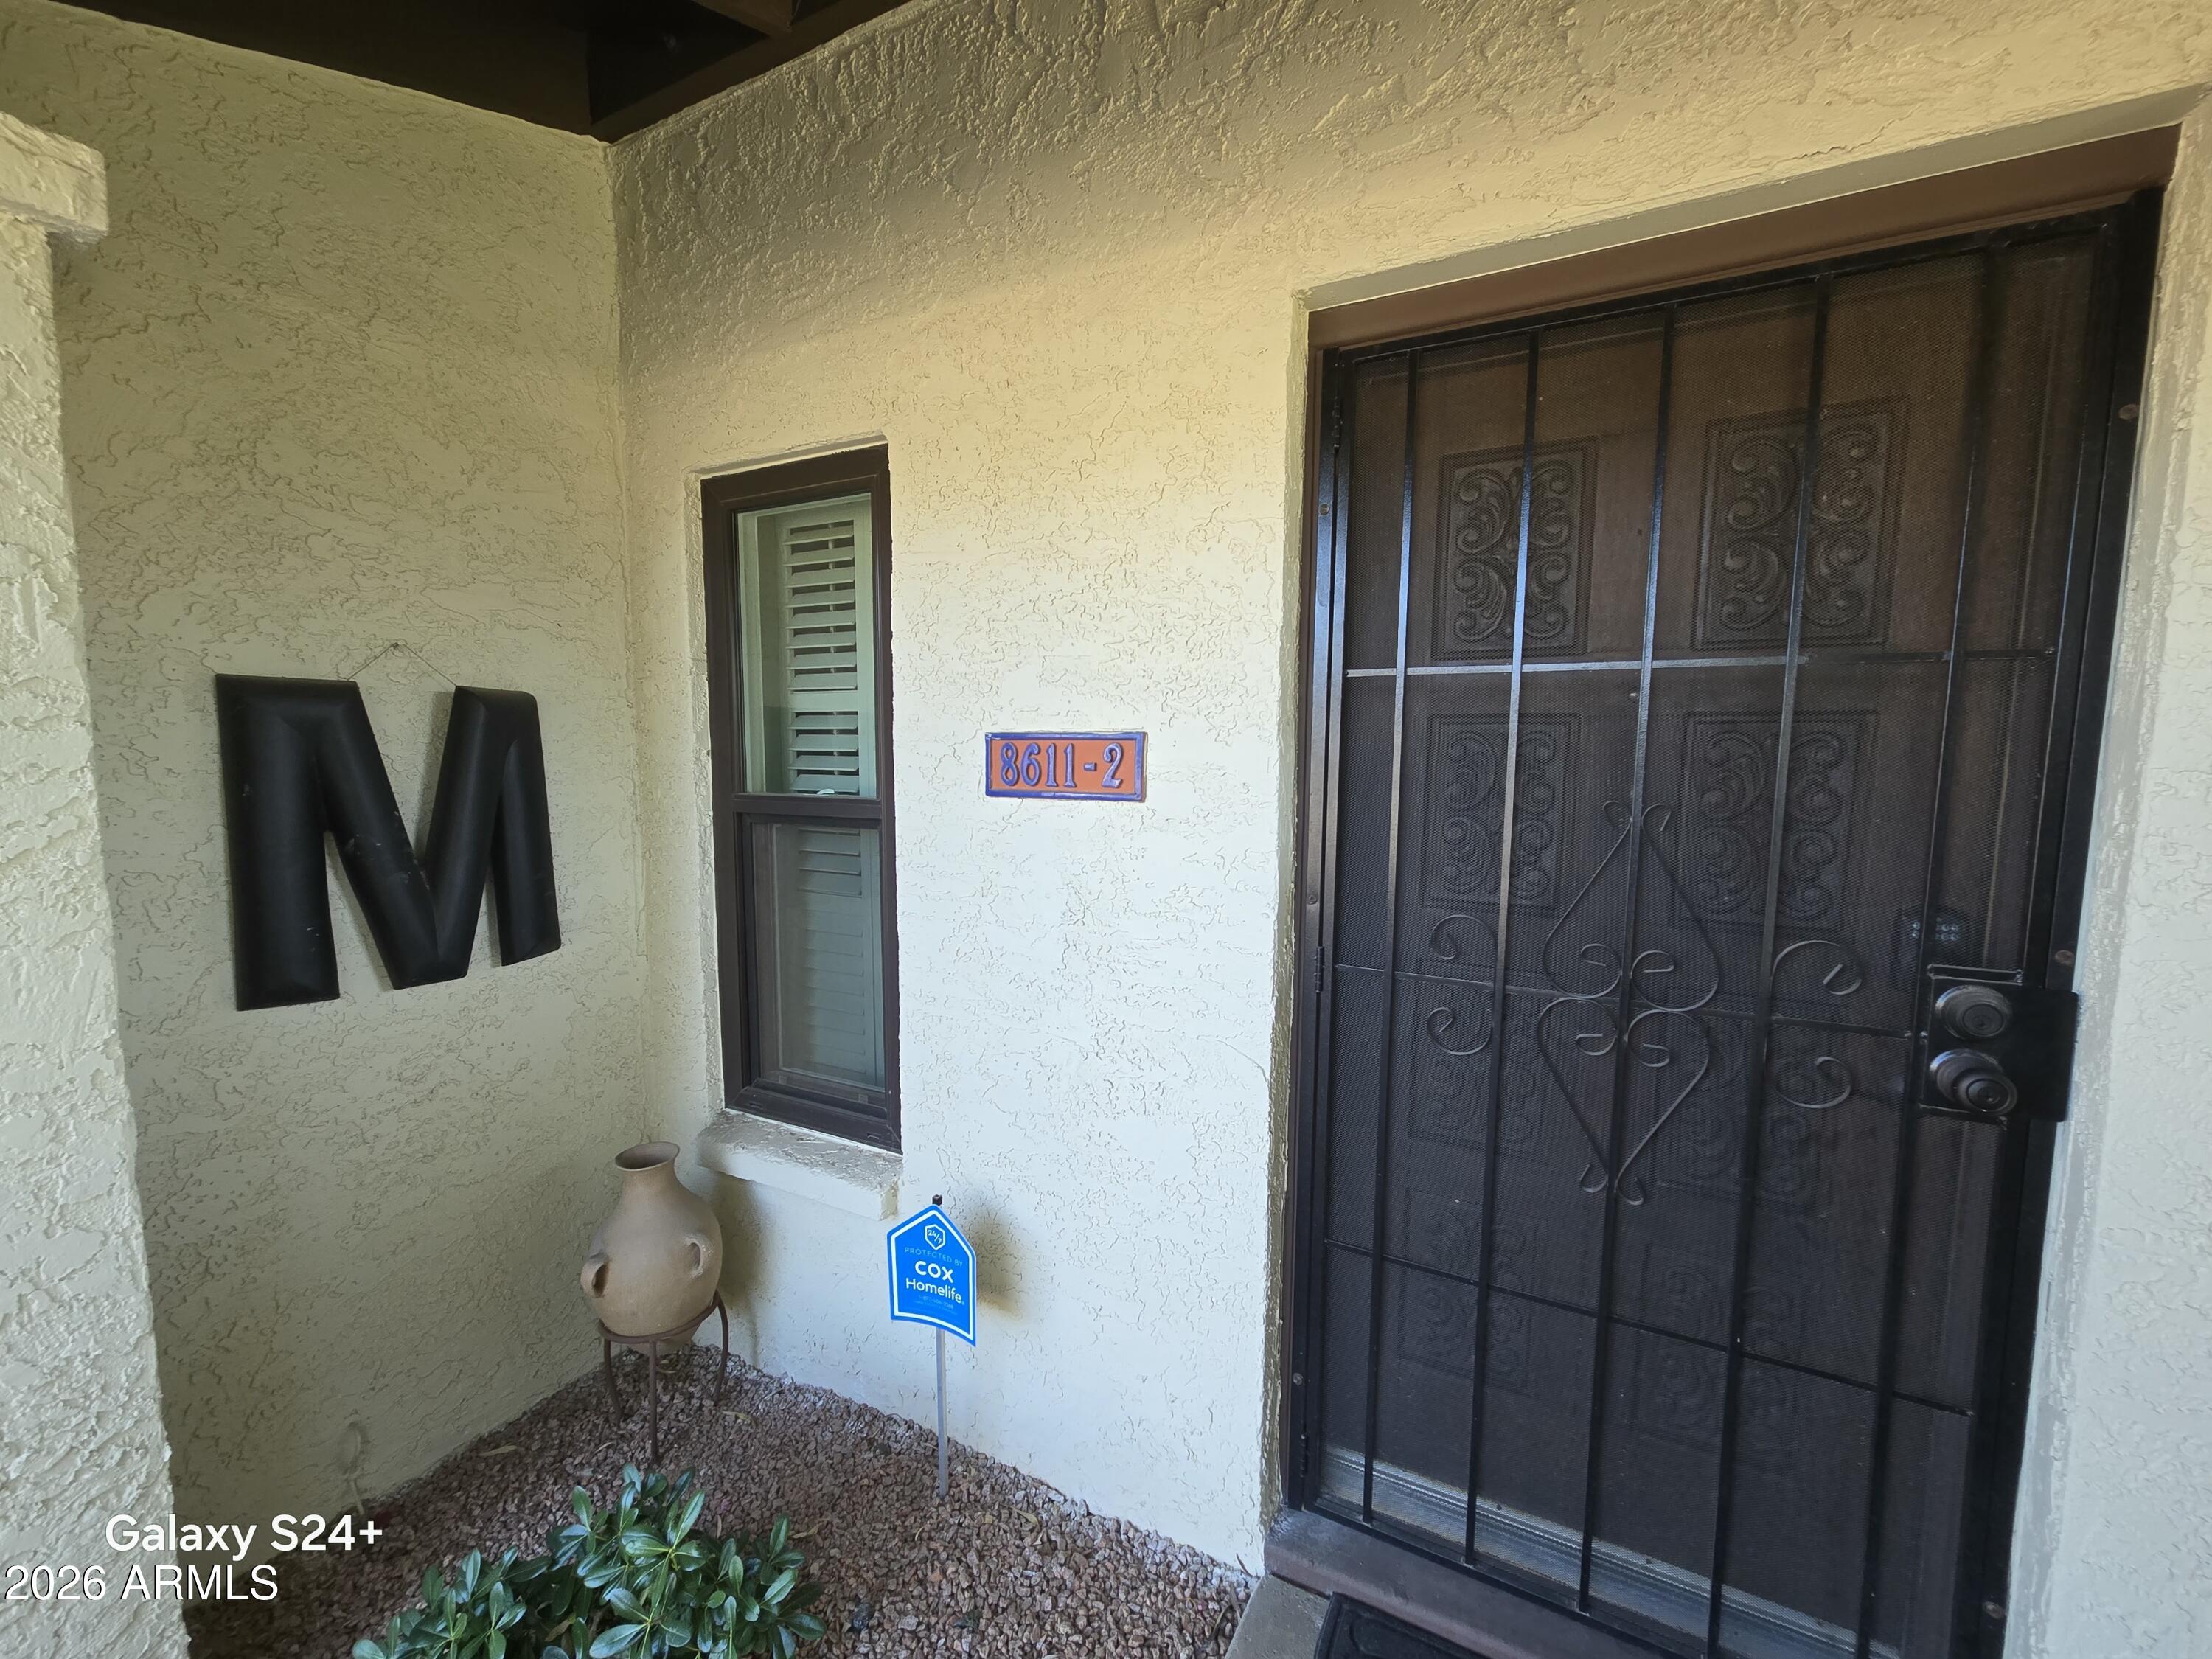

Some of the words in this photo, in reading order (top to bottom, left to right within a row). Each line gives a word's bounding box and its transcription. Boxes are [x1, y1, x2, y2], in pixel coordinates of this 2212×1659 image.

[1001, 742, 1122, 788] 8611-2
[215, 674, 562, 1011] M
[928, 1229, 942, 1244] 24/7
[904, 1247, 952, 1263] PROTECTED
[954, 1259, 963, 1267] BY
[914, 1260, 953, 1283] COX
